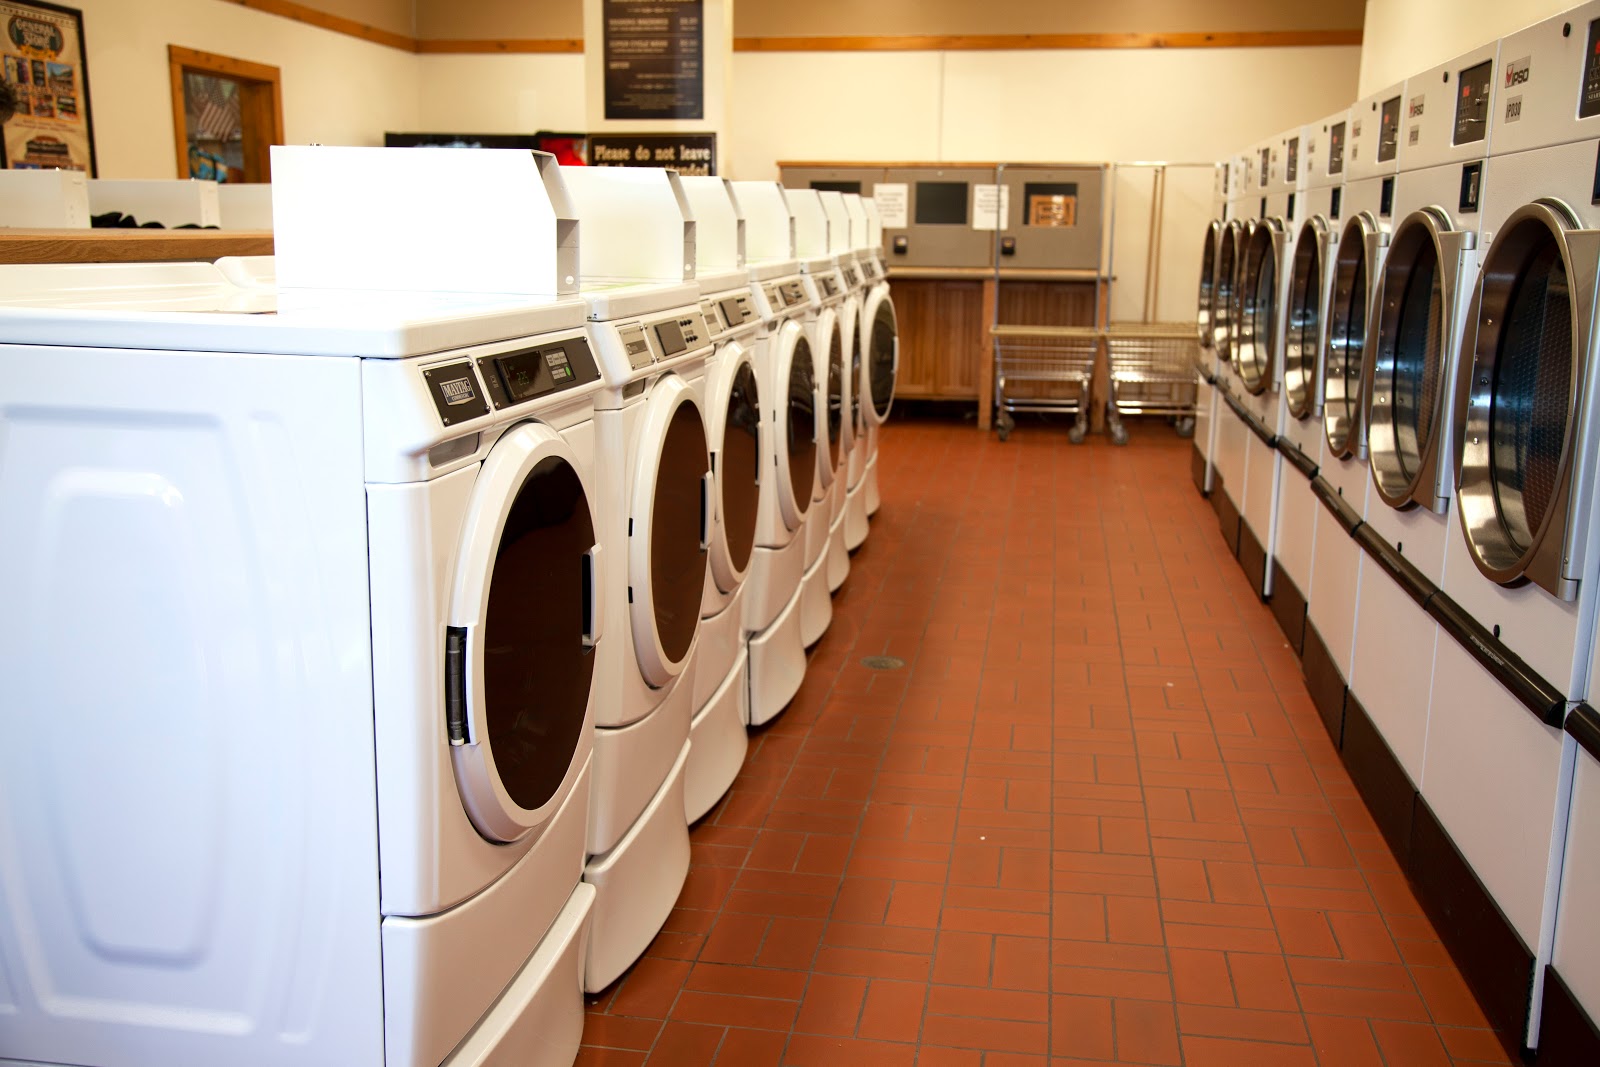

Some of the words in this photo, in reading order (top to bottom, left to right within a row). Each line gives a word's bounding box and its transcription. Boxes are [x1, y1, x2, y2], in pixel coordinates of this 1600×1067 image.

[594, 145, 631, 160] Please
[634, 144, 651, 160] do
[655, 146, 676, 160] not
[680, 144, 711, 160] leave
[442, 380, 470, 397] MAYTAG
